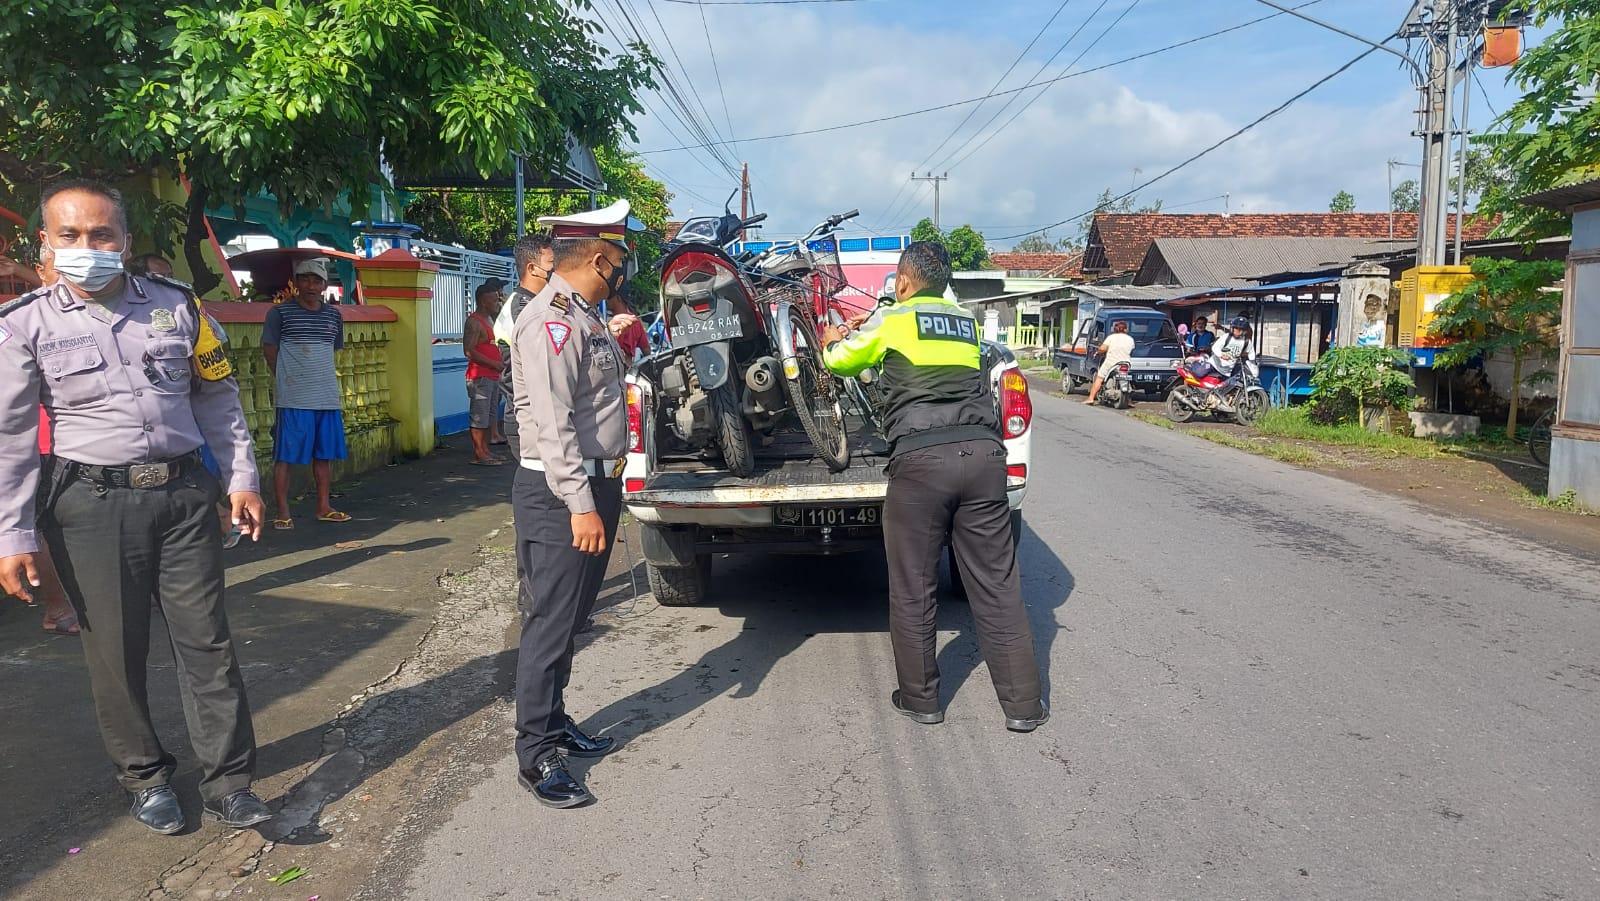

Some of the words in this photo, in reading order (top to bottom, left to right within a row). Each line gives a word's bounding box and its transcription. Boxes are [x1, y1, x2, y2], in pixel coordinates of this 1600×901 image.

[671, 326, 686, 338] AG
[687, 319, 715, 334] 5242
[718, 314, 741, 328] RAK
[919, 316, 976, 340] POLISI
